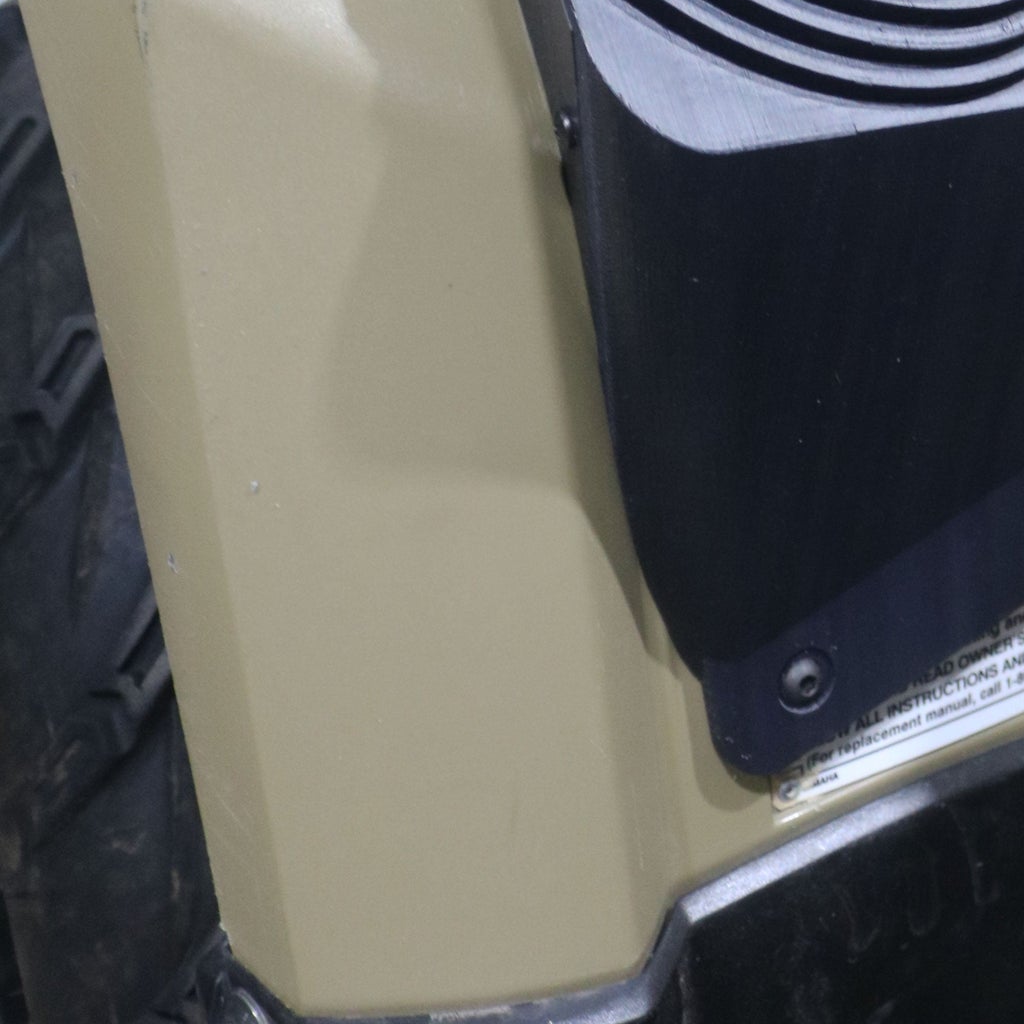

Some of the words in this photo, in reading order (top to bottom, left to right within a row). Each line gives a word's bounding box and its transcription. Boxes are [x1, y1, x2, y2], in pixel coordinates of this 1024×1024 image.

[806, 749, 834, 771] (For
[838, 714, 922, 755] replacement
[926, 692, 977, 722] manual,
[980, 681, 1002, 700] call
[856, 711, 884, 732] ALL
[886, 663, 998, 718] INSTRUCTIONS
